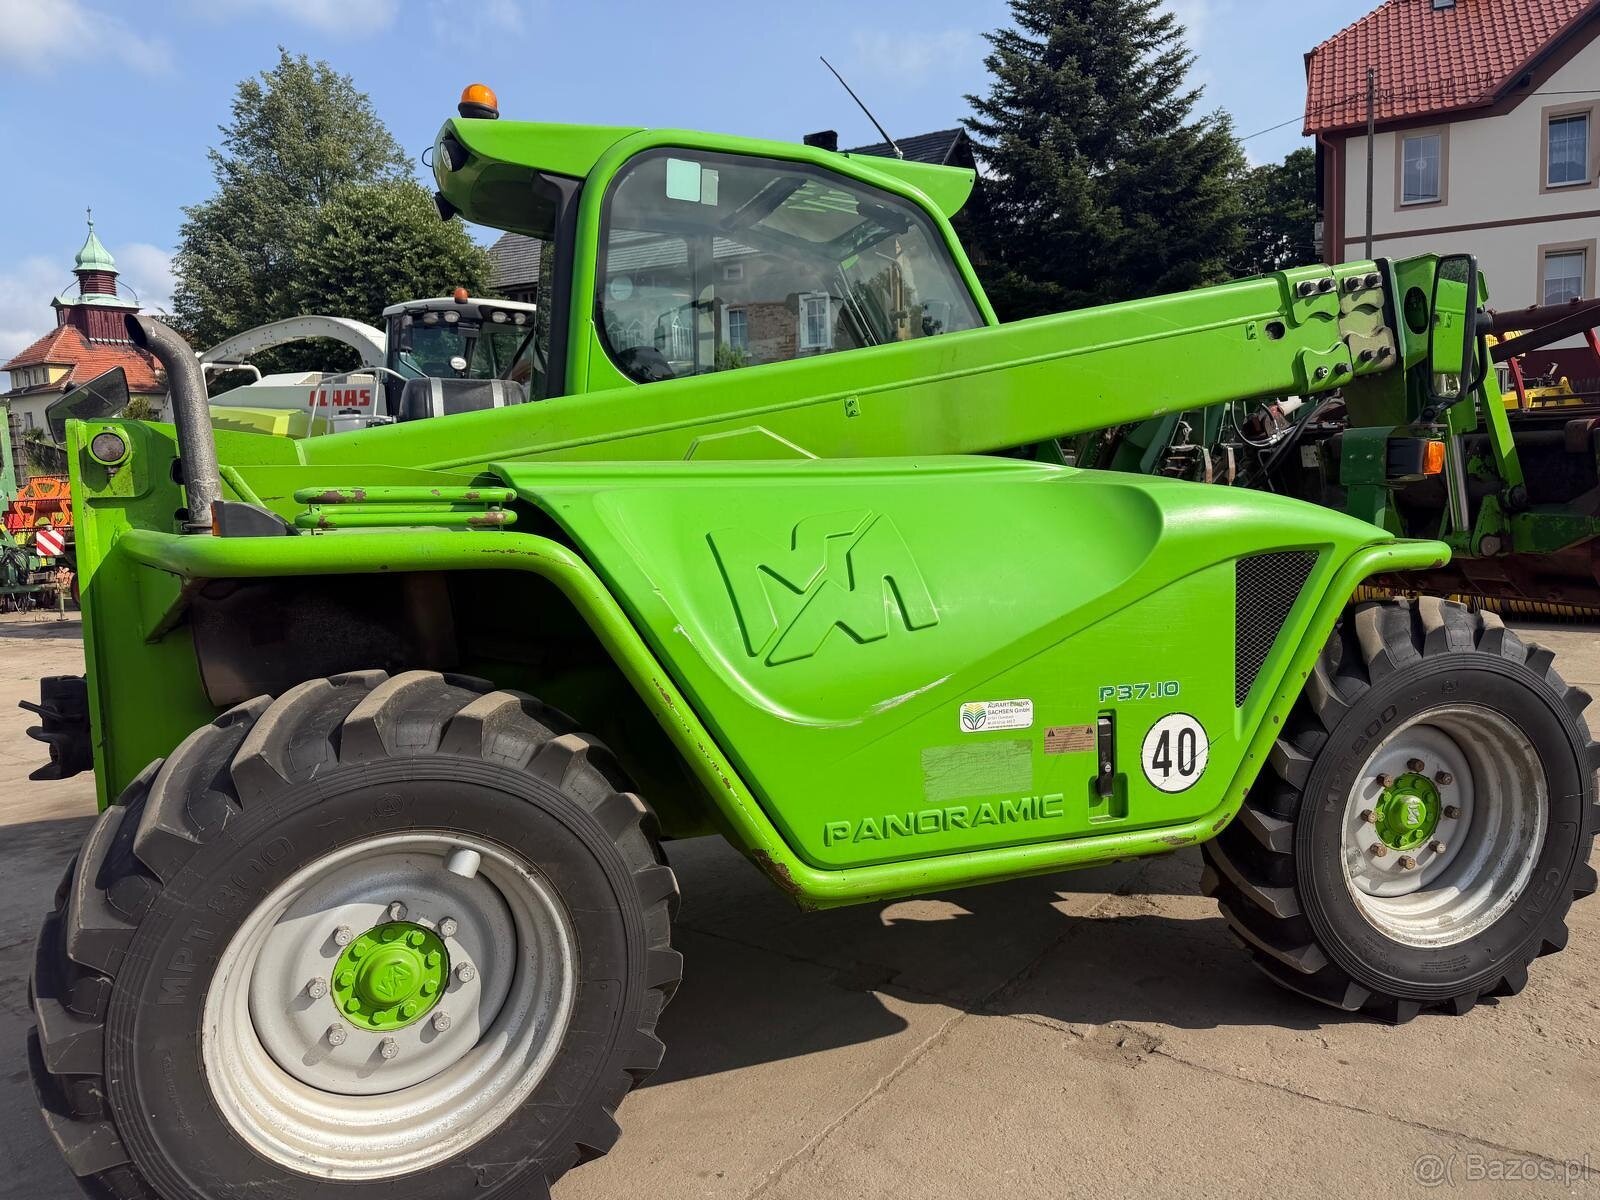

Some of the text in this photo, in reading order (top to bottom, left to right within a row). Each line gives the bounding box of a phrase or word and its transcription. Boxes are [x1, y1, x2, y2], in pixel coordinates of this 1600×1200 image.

[309, 389, 370, 407] CLAAS
[1099, 680, 1180, 702] P37.10
[1151, 726, 1197, 778] 40
[824, 793, 1064, 847] PANORAMIC
